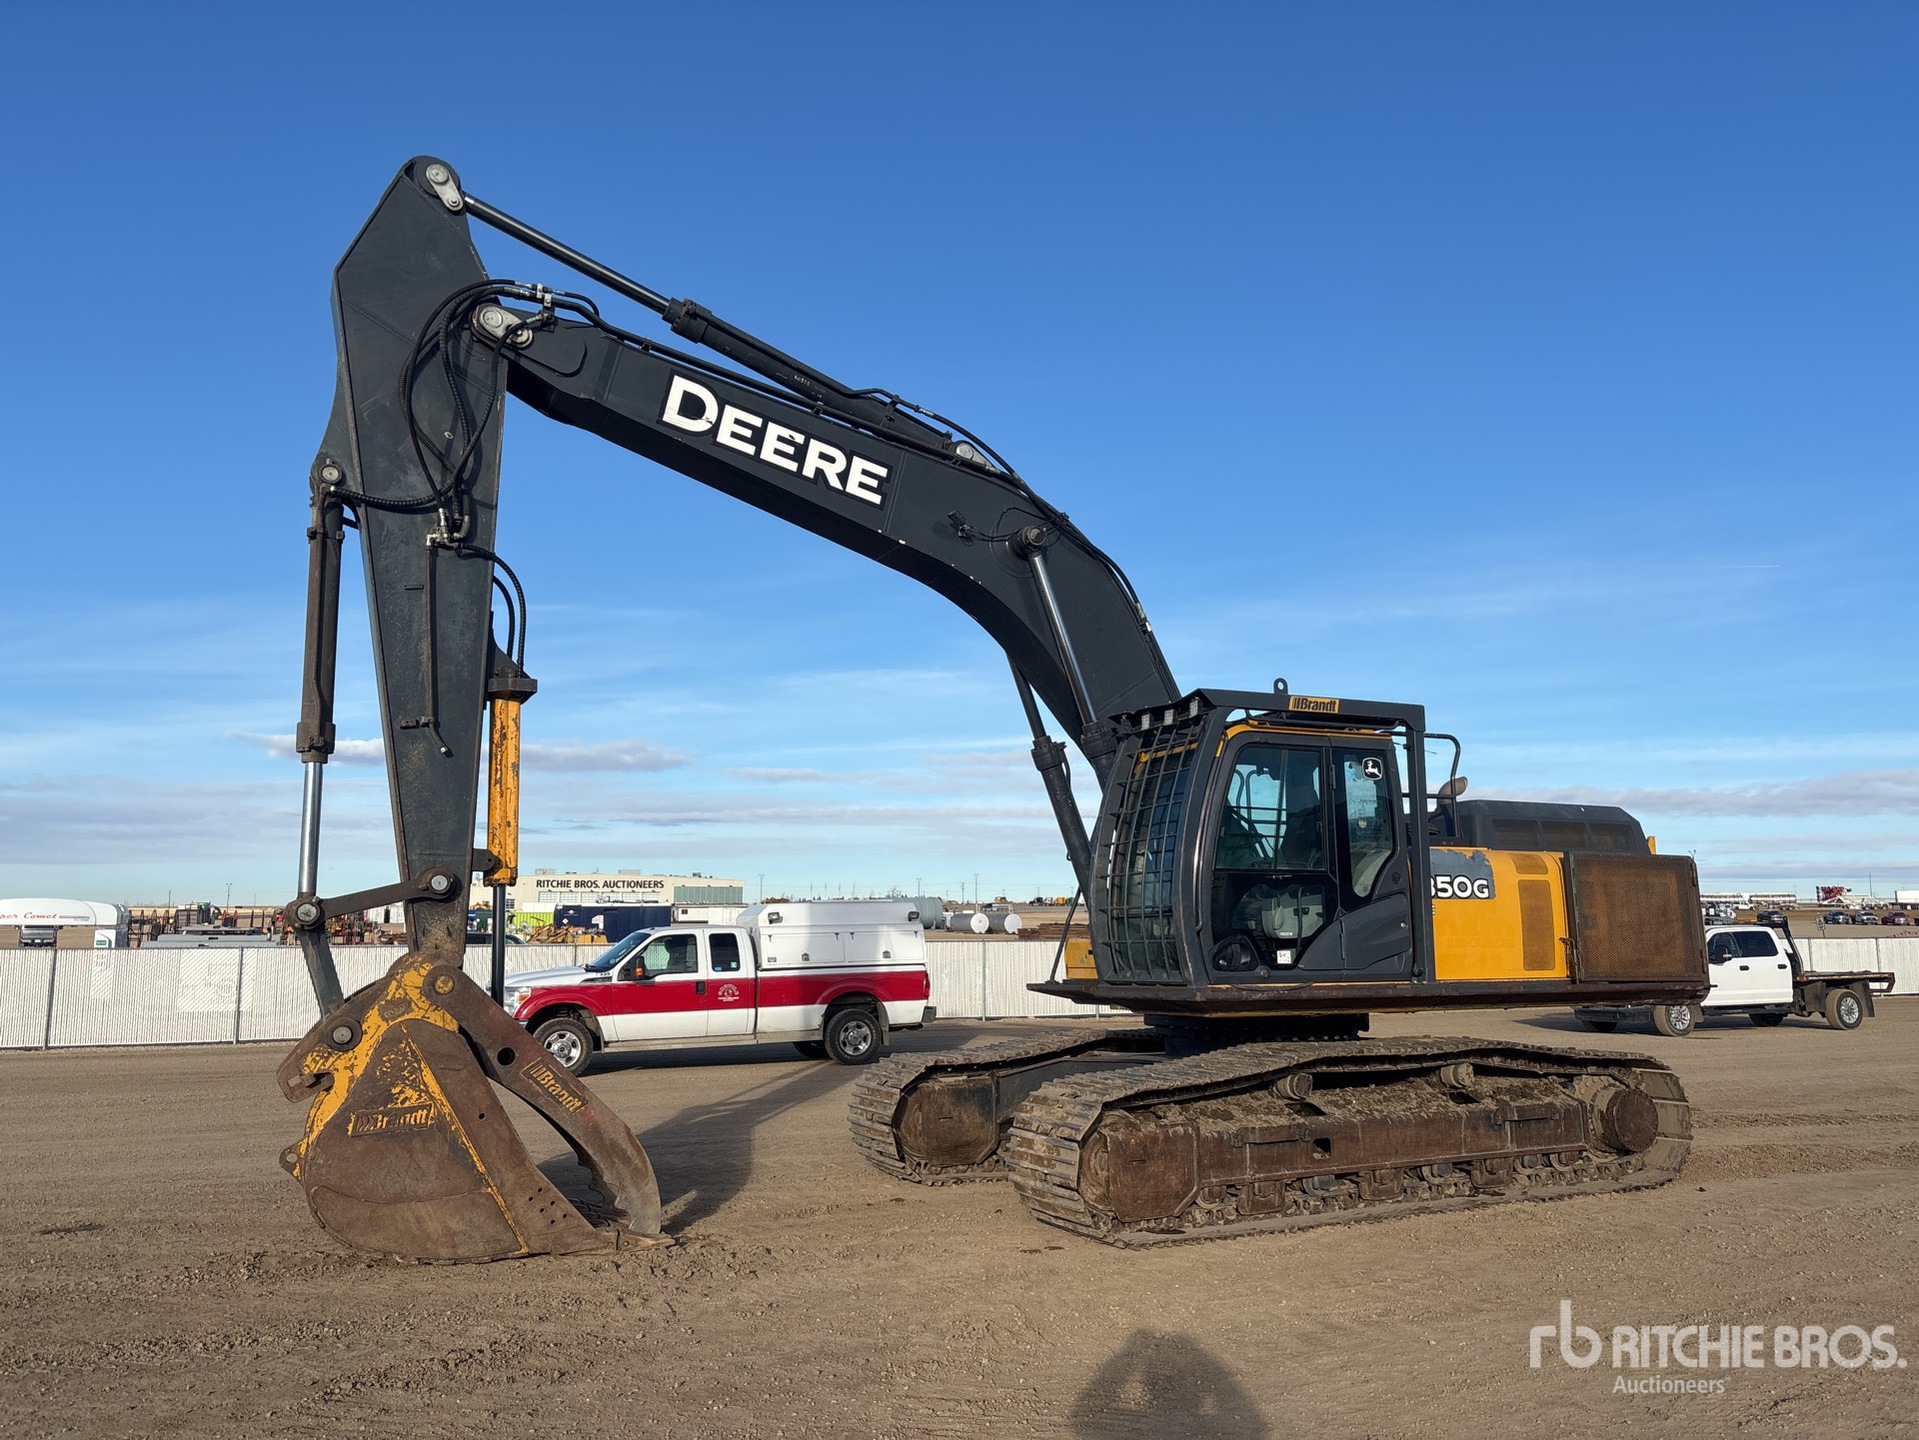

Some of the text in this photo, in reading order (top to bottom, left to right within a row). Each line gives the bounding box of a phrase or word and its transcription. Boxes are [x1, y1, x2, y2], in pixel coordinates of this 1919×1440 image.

[662, 374, 889, 505] DEERE
[1299, 697, 1337, 712] Brandt
[536, 879, 664, 889] RITCHIE BROS. AUCTIONEERS
[23, 911, 58, 919] Comet
[538, 1069, 582, 1112] Brandt
